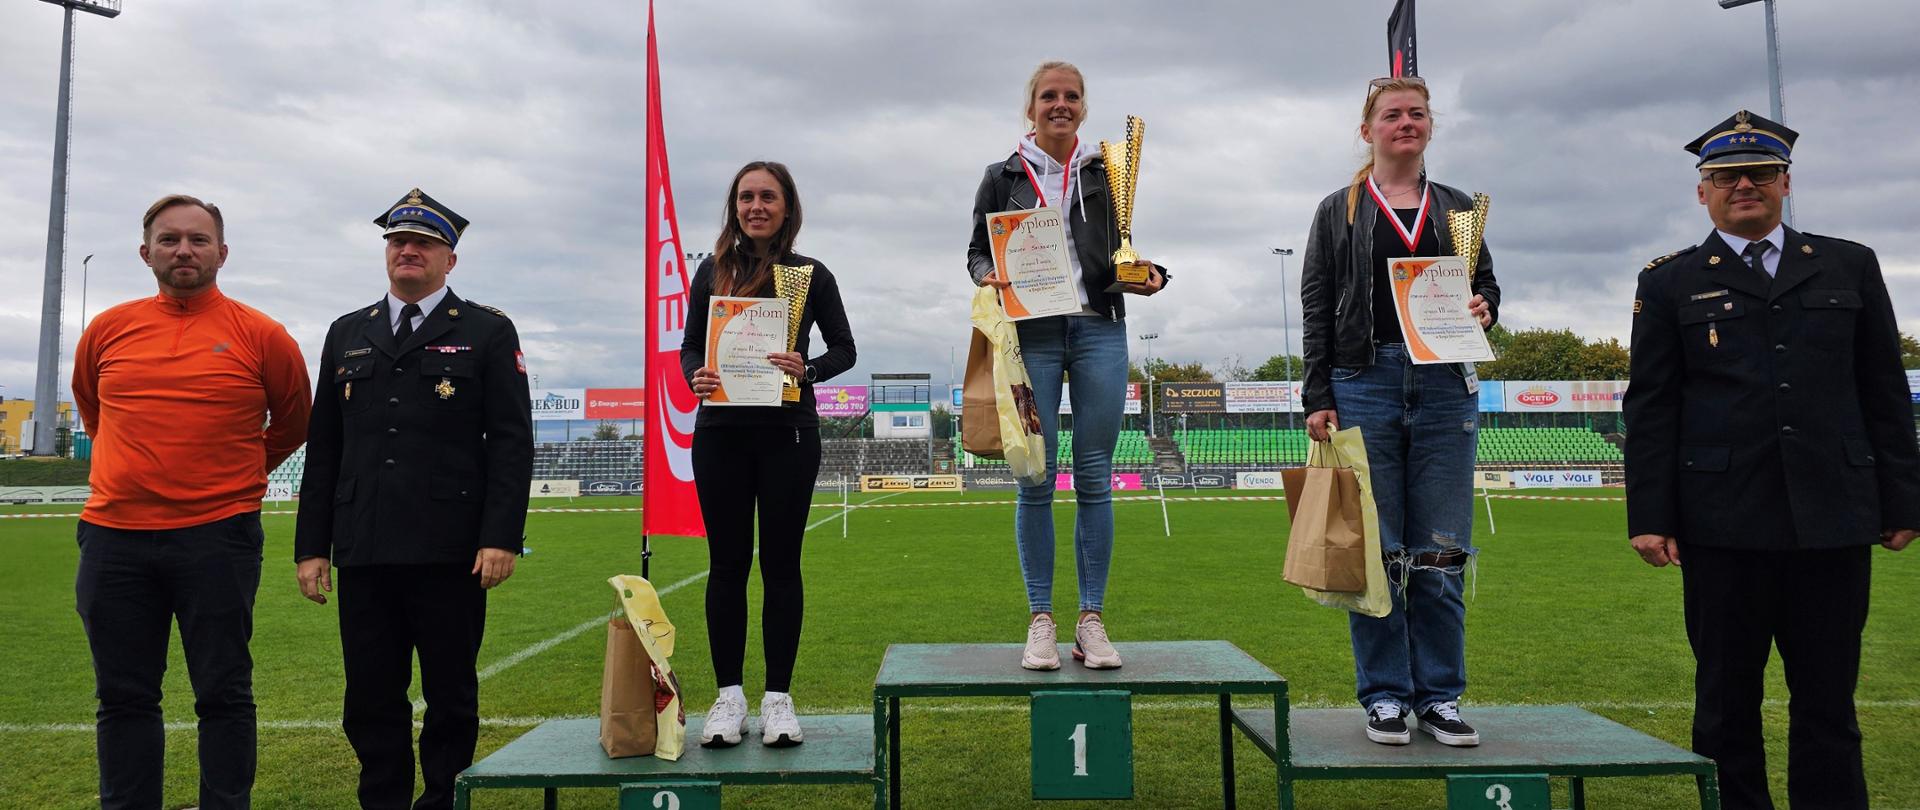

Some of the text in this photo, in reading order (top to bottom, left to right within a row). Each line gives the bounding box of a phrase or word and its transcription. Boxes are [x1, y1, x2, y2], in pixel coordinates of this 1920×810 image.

[1010, 217, 1059, 234] Dyplom
[1412, 265, 1464, 281] Dyplom
[733, 304, 783, 321] Dyplom
[1181, 389, 1221, 397] SZCZUCKI
[1524, 474, 1593, 483] WOLF WOLF
[1068, 723, 1088, 776] 1
